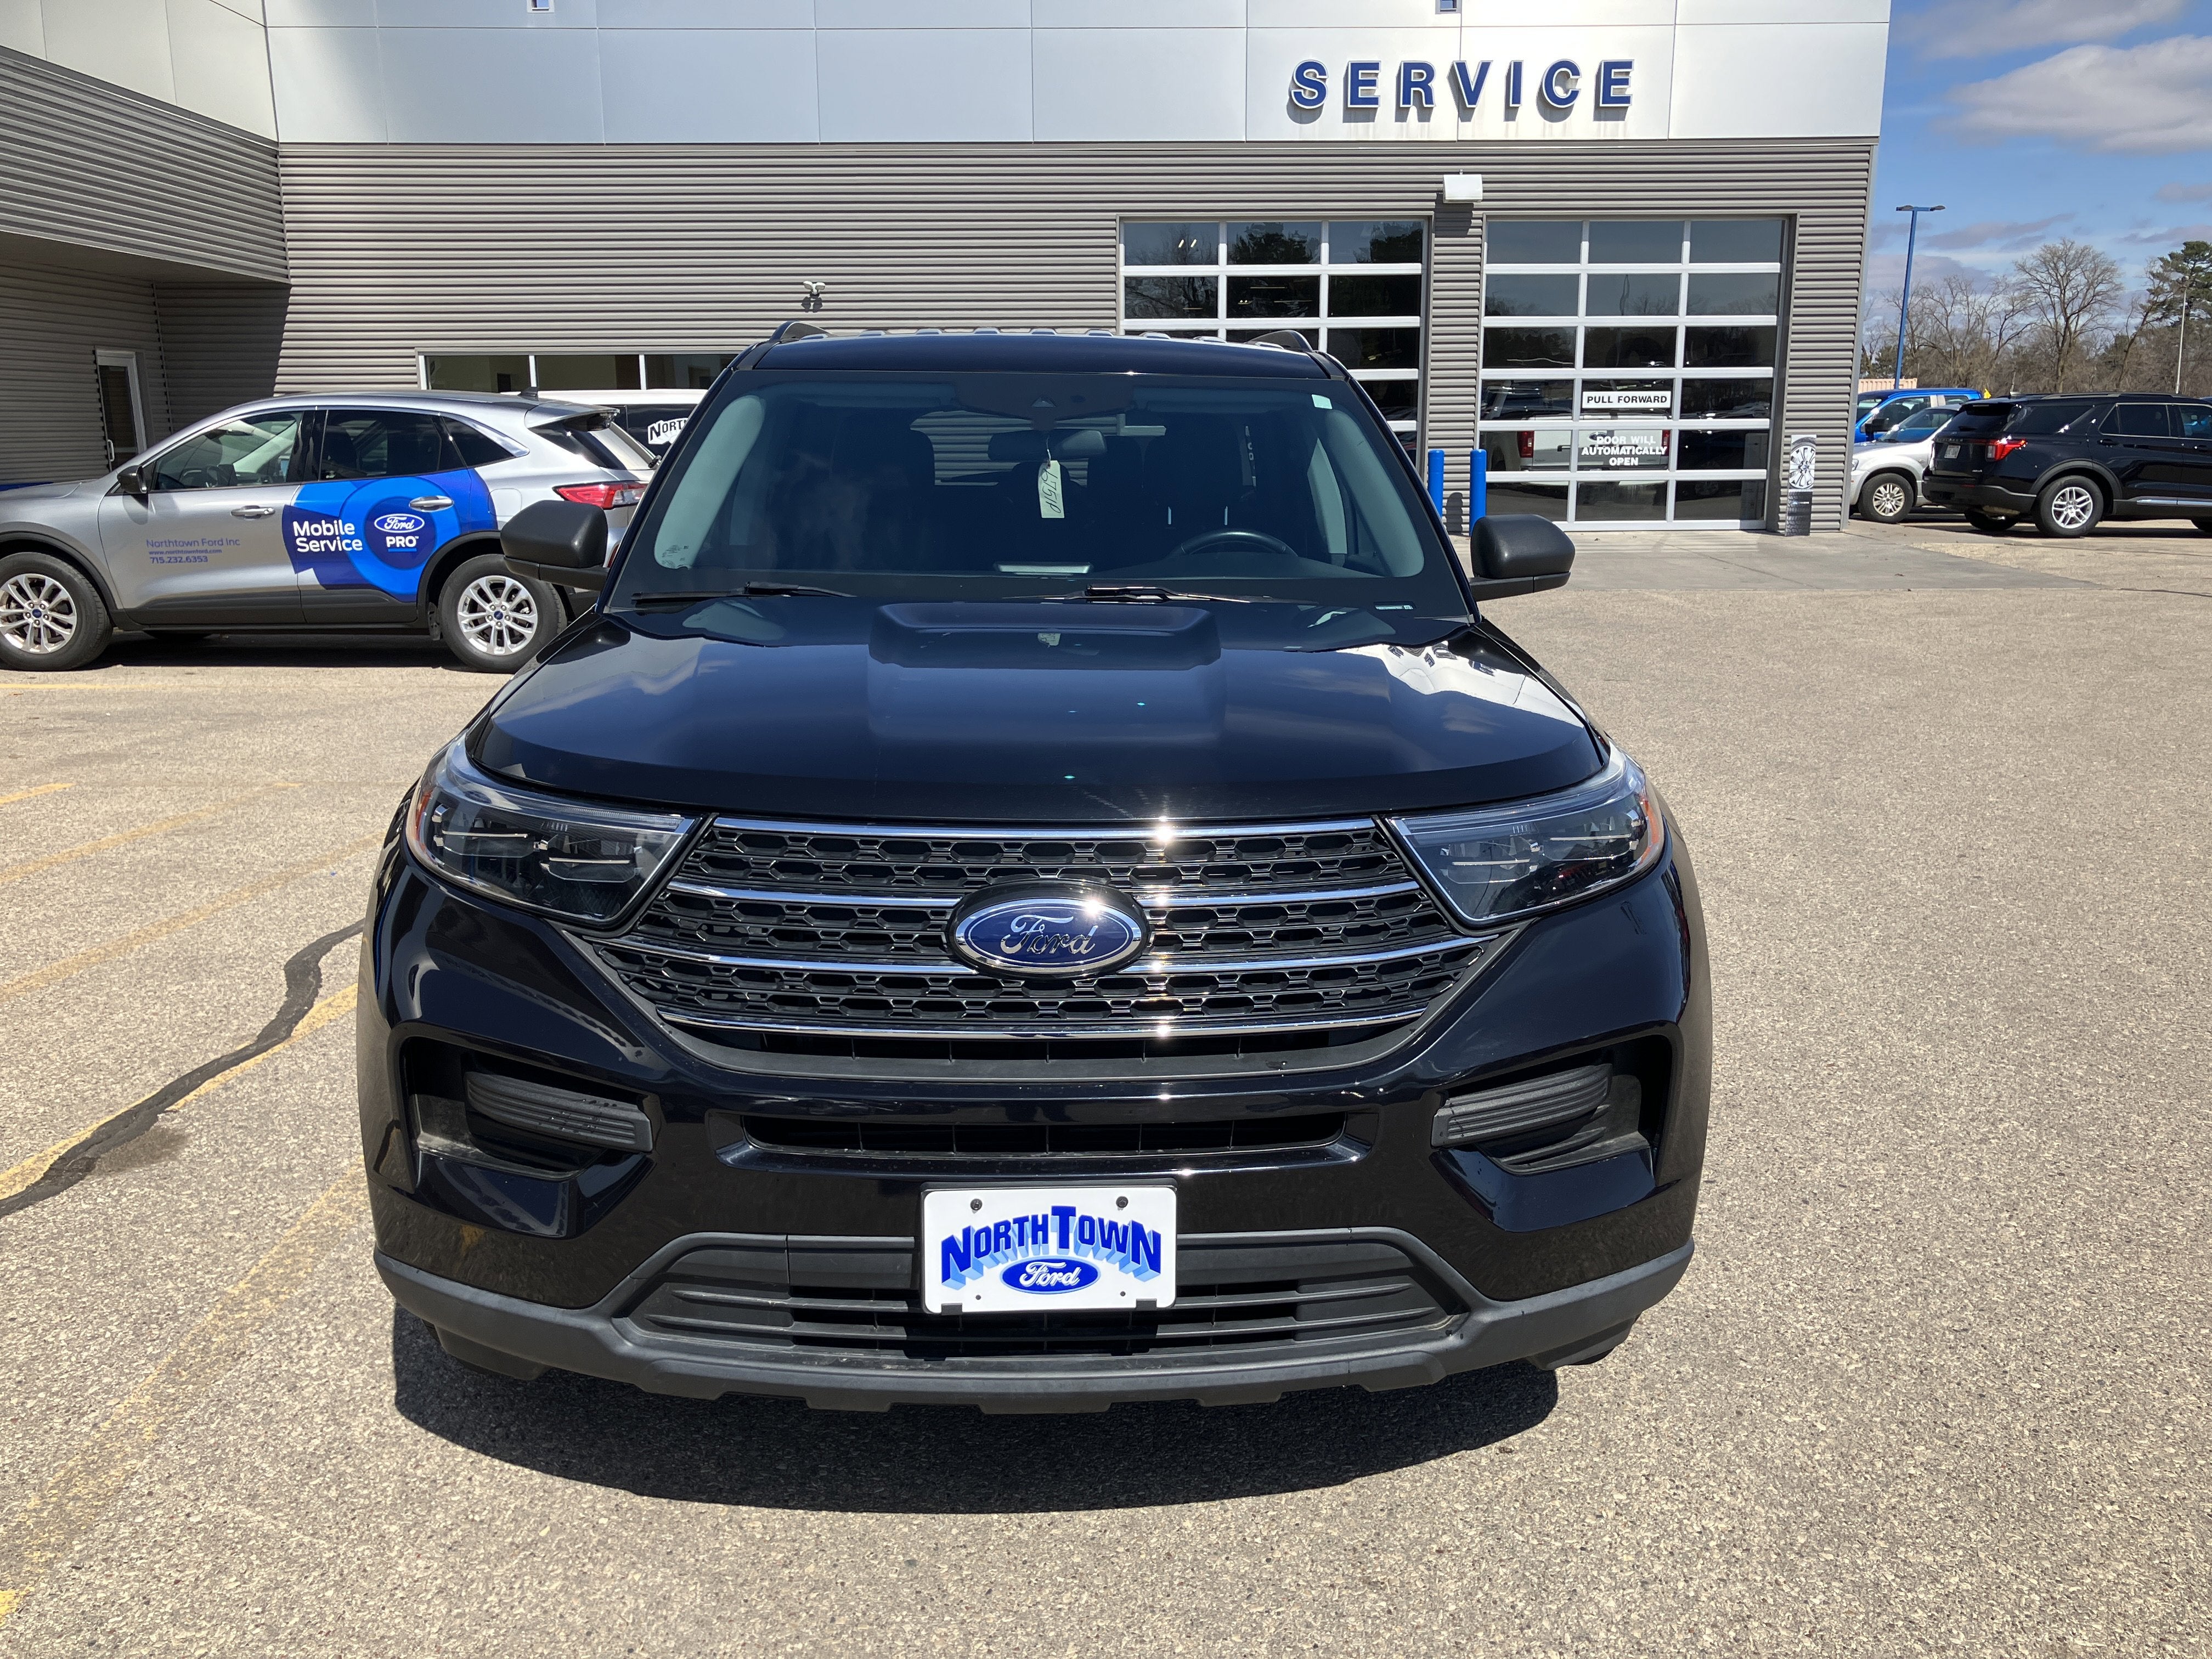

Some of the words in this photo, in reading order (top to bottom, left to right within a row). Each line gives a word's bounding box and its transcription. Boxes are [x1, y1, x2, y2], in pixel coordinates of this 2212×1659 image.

[1290, 59, 1635, 109] SERVICE
[1587, 396, 1613, 404] PULL
[649, 418, 687, 441] NORT
[1596, 436, 1627, 445] DOOR
[1630, 436, 1656, 444] WILL
[1581, 446, 1668, 455] AUTOMATICALLY
[1609, 457, 1639, 466] OPEN
[292, 519, 356, 537] Mobile
[383, 516, 415, 530] Ford
[146, 539, 200, 548] Northtown
[201, 538, 224, 546] Ford
[225, 538, 240, 546] Inc
[295, 537, 363, 552] Service
[149, 556, 208, 564] 715.232.6353
[1000, 914, 1099, 955] Ford
[1019, 1261, 1082, 1287] Ford
